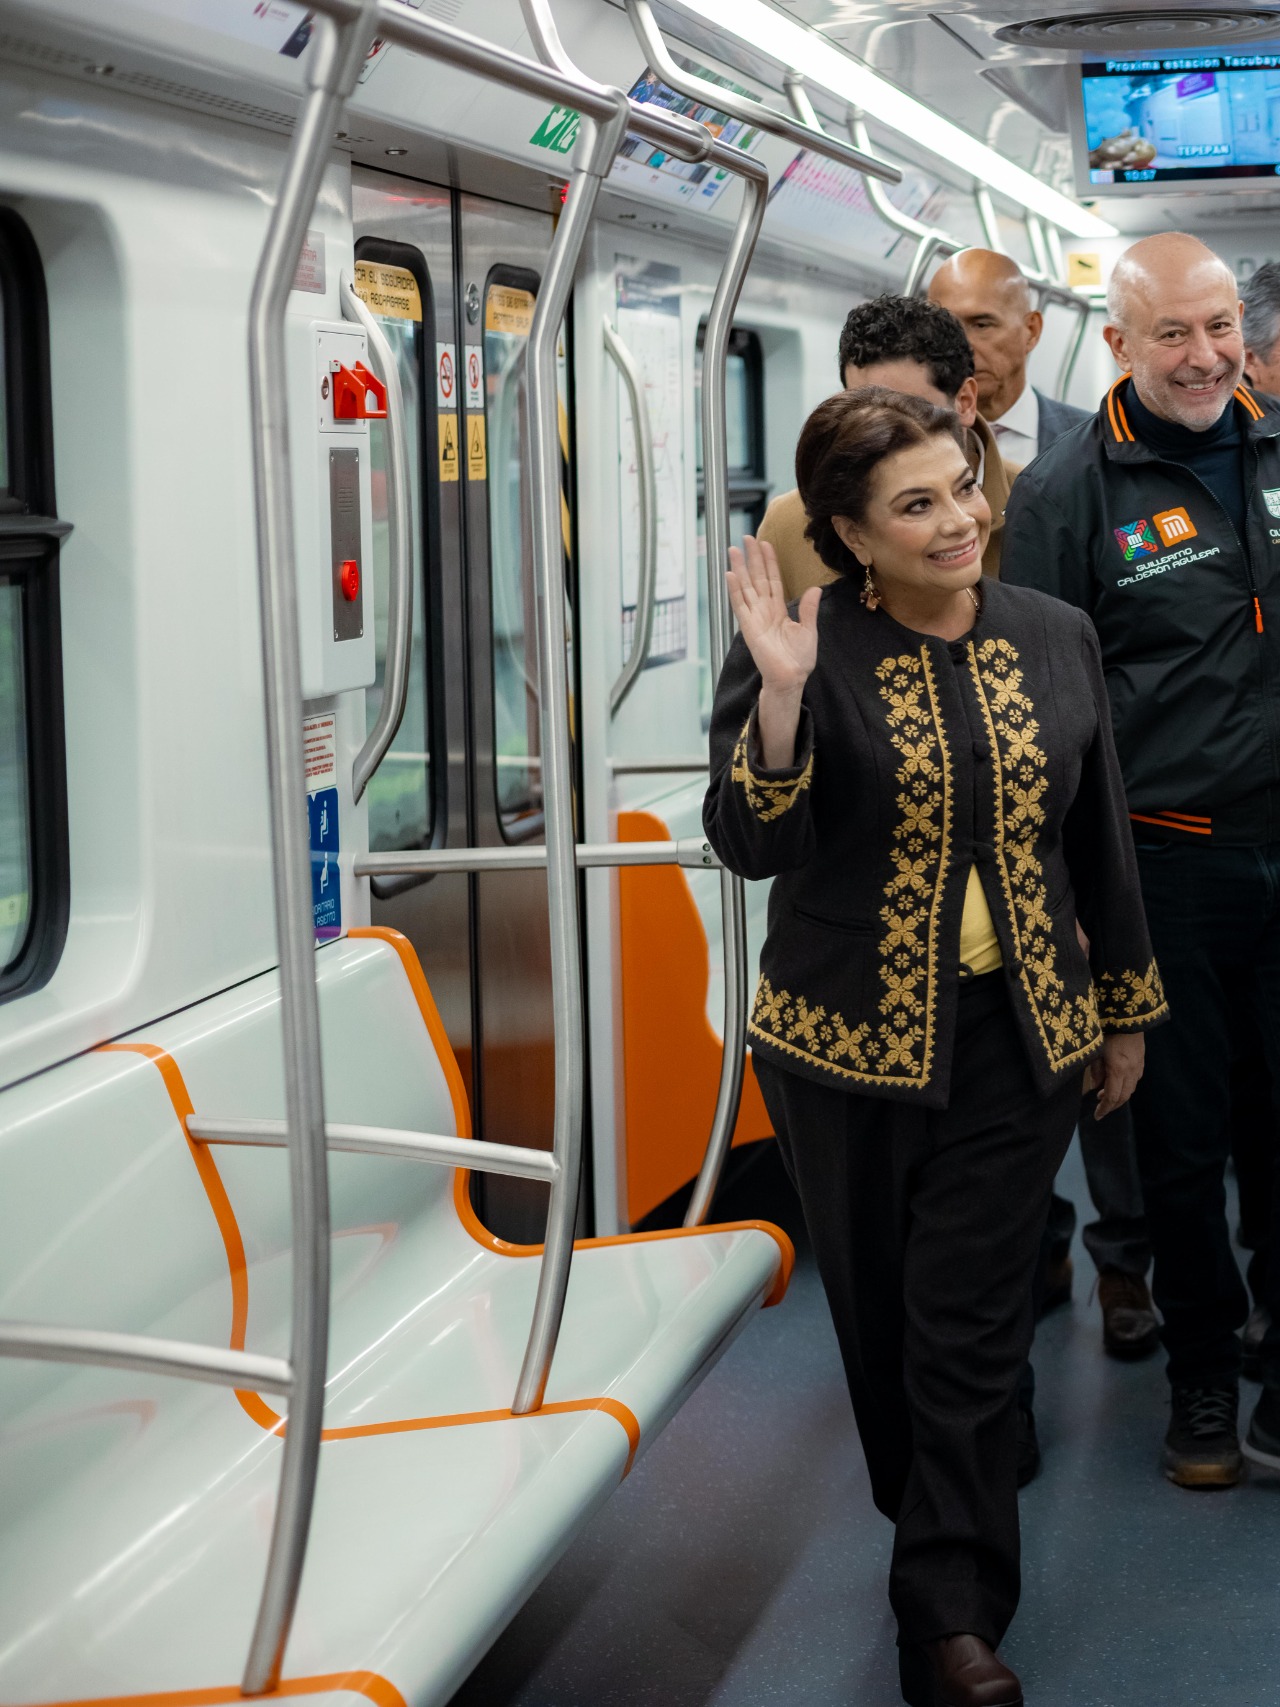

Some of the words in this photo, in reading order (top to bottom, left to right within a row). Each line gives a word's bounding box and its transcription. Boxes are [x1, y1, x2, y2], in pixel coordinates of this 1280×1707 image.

[1106, 59, 1160, 72] Proxima
[1163, 57, 1220, 70] estacion
[1177, 145, 1230, 158] TEPEPAN
[1117, 564, 1171, 587] CALDERÓN
[1172, 547, 1220, 569] AGUILERA
[1136, 547, 1193, 572] GUILLERMO
